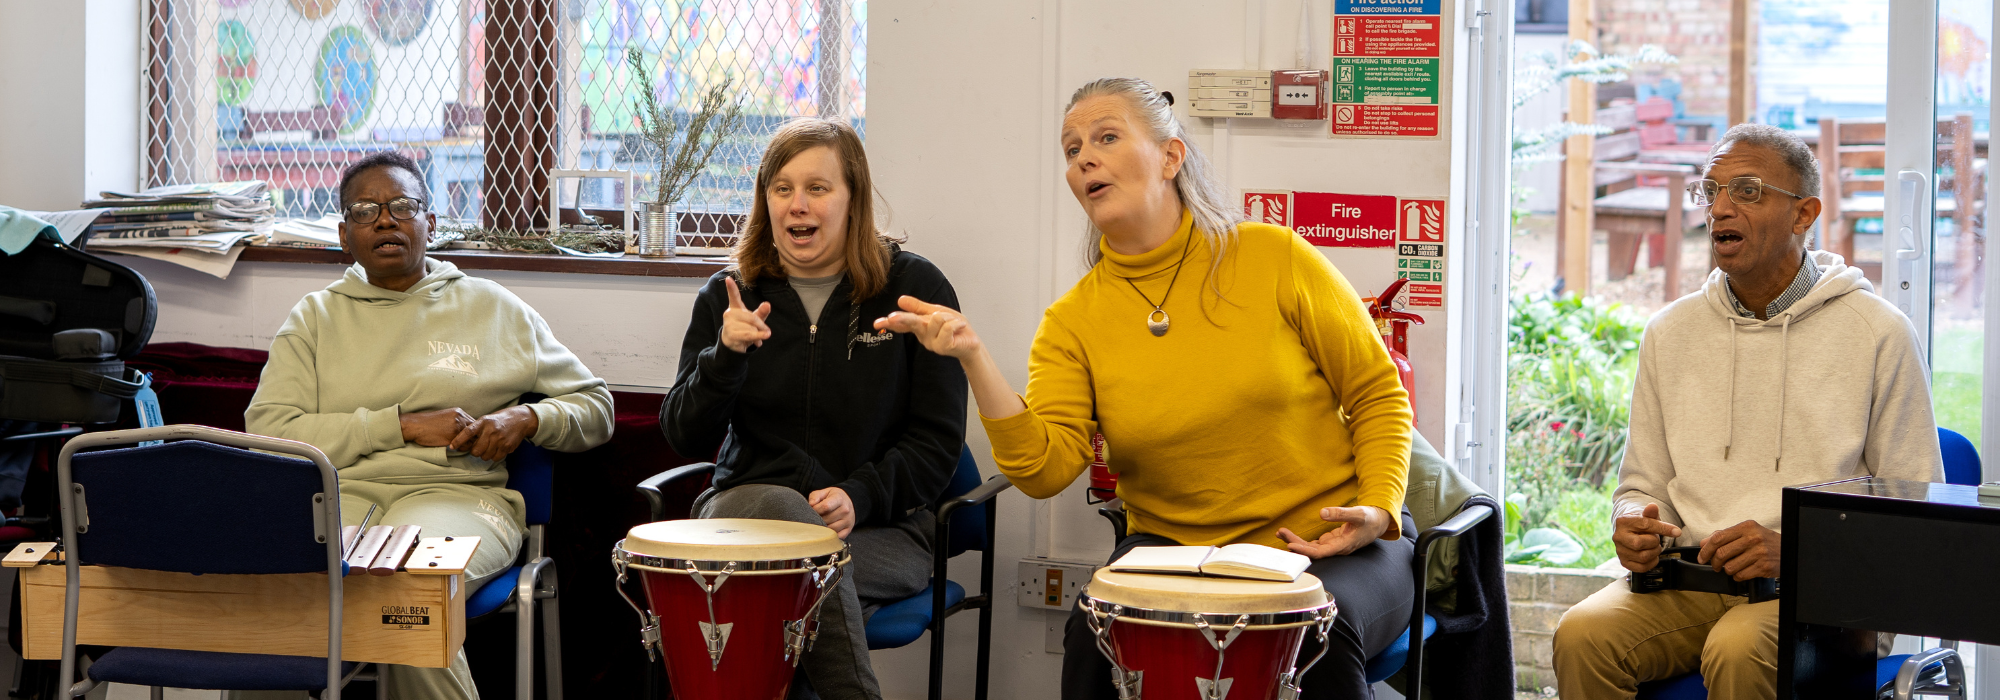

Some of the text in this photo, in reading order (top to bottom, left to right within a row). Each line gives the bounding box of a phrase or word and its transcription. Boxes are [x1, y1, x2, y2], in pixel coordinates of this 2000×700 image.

[1331, 203, 1362, 218] Fire
[1296, 224, 1396, 241] extinguisher
[856, 332, 893, 343] ellesse
[428, 341, 480, 361] NEVADA
[396, 616, 423, 624] SONOR
